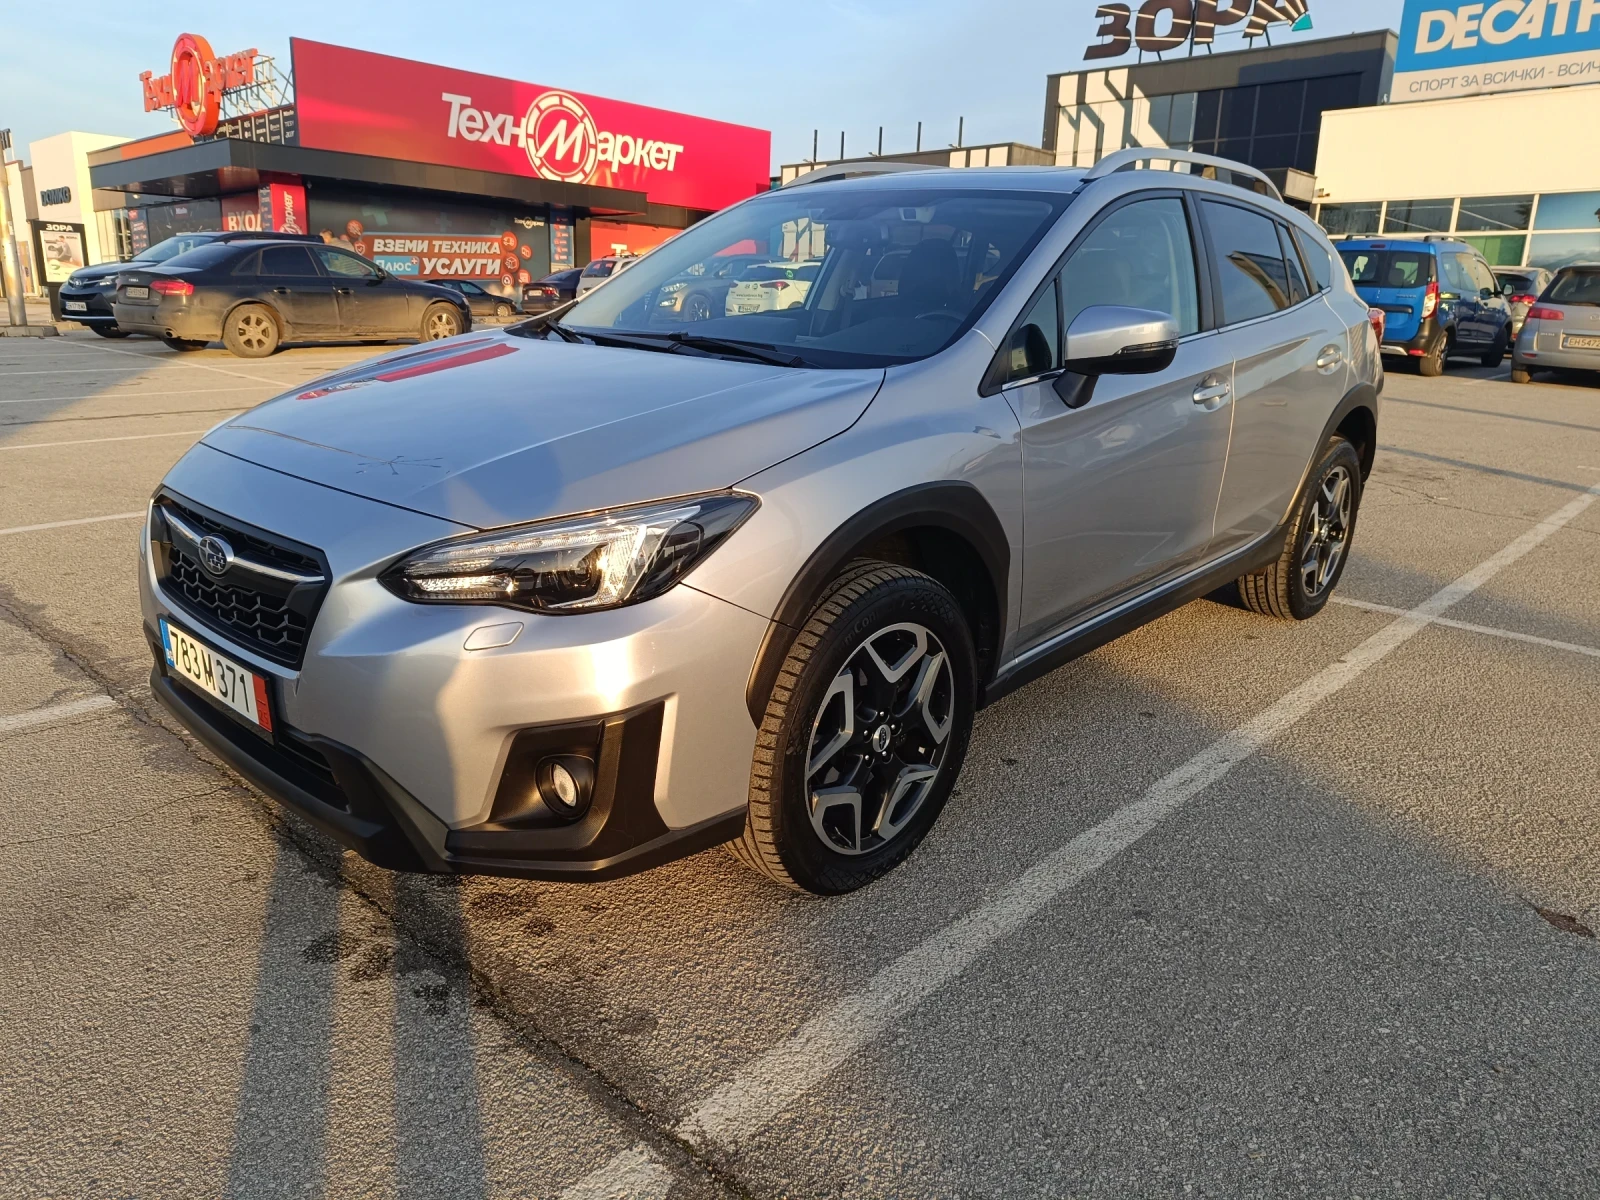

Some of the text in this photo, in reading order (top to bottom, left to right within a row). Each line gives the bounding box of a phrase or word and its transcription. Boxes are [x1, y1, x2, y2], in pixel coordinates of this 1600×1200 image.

[1409, 76, 1458, 94] СПОРТ
[1460, 75, 1479, 88] ЗА
[1483, 66, 1545, 86] ВСИЧКИ
[45, 223, 74, 232] ЗОРА
[373, 239, 501, 254] ВЗЕМИ ТЕХНИКА
[422, 257, 501, 275] УСЛУГИ
